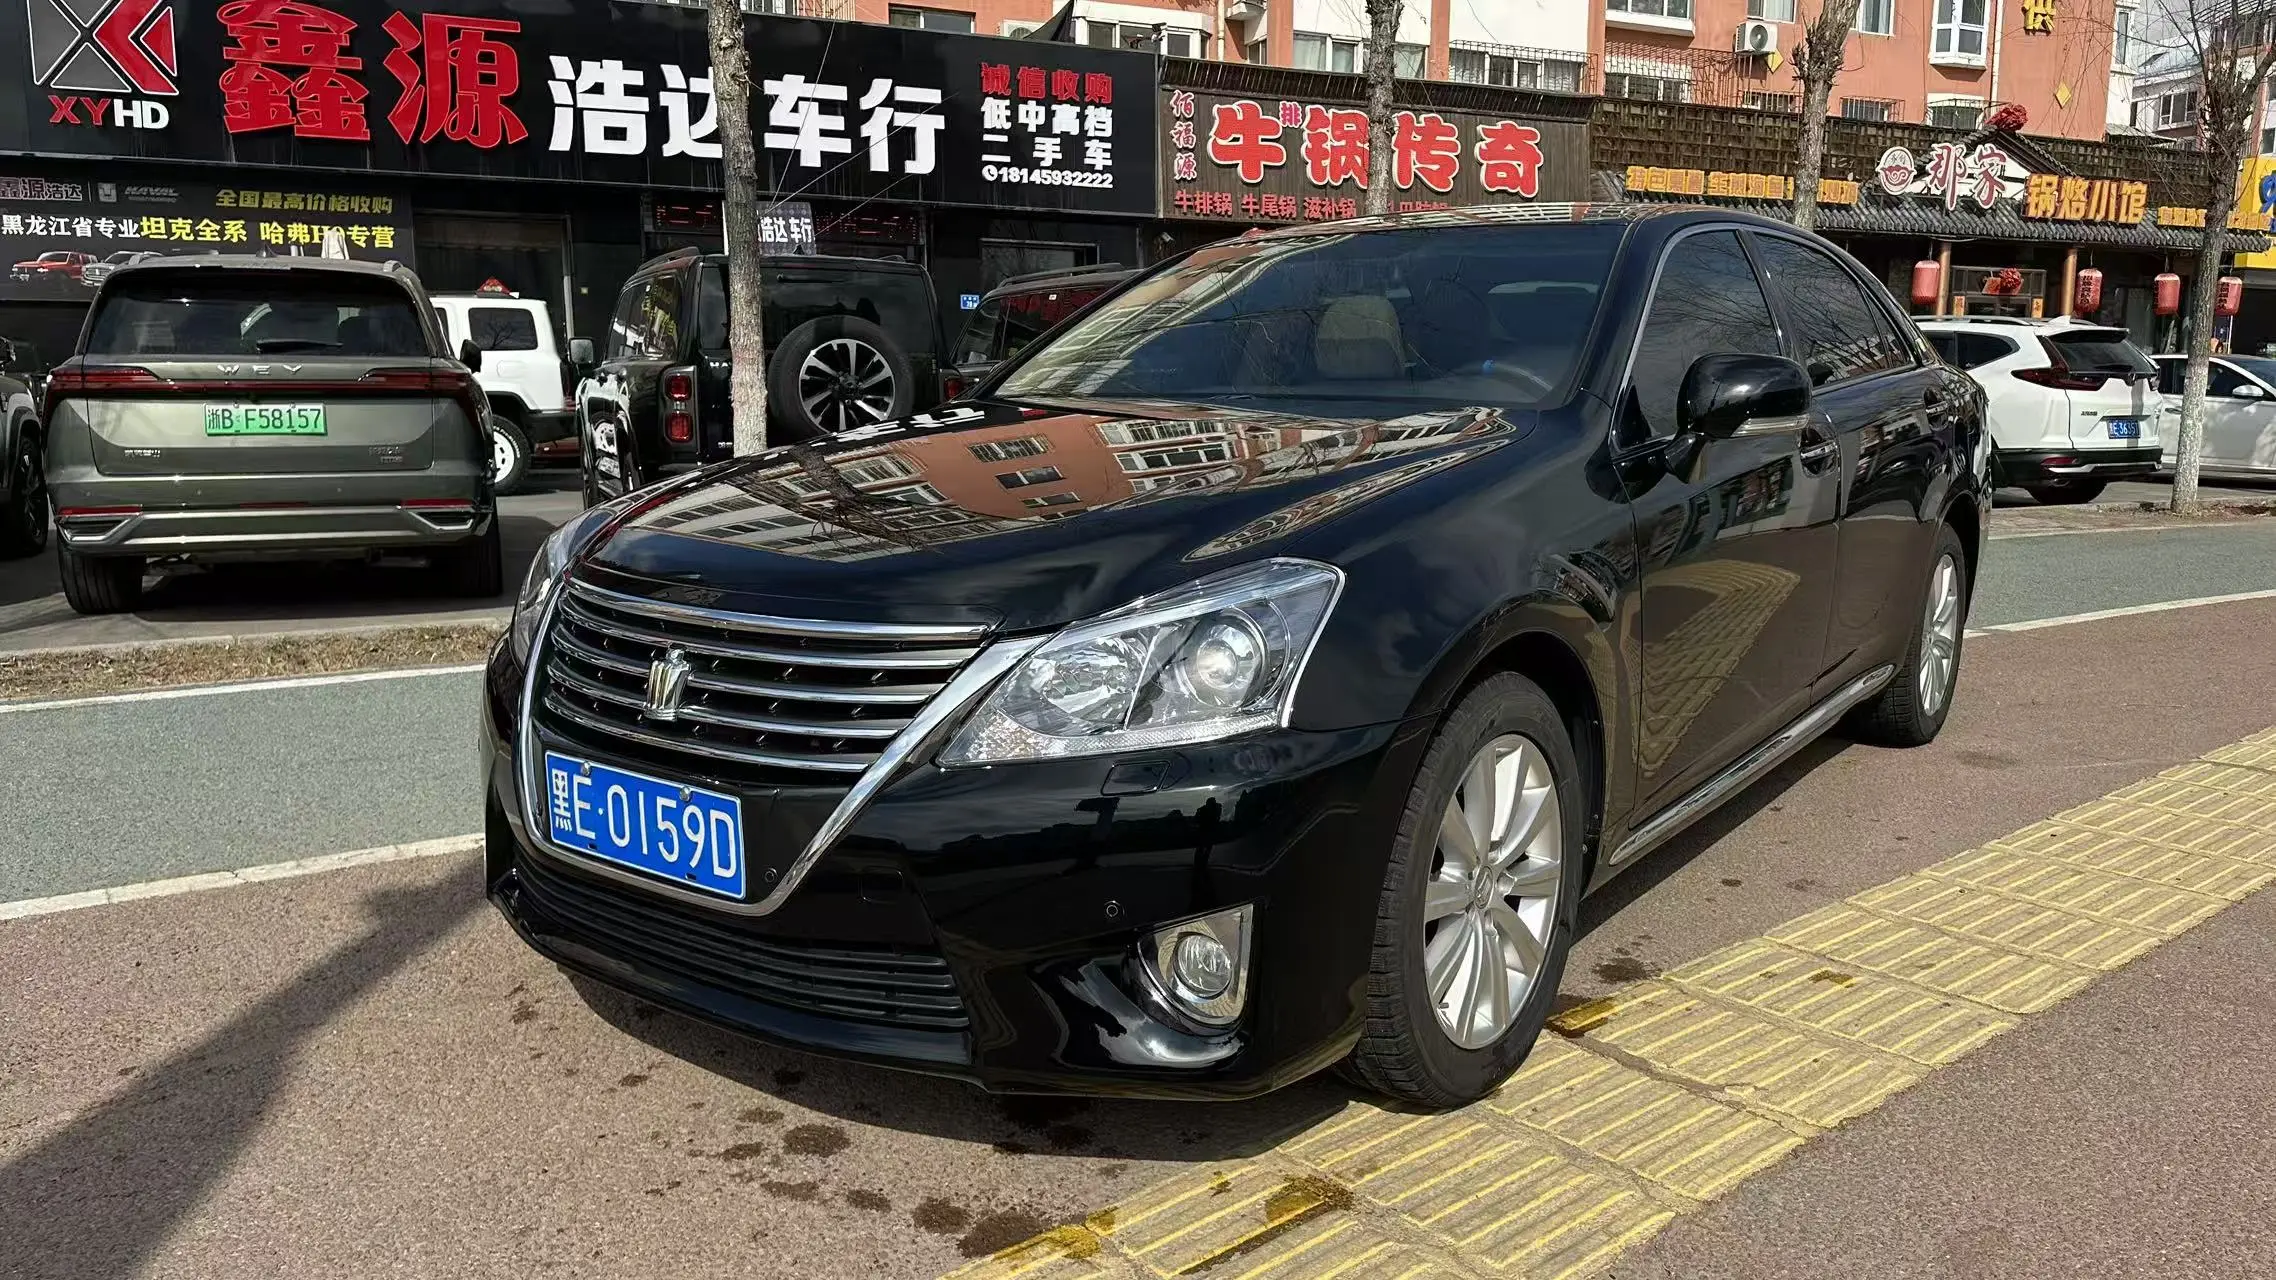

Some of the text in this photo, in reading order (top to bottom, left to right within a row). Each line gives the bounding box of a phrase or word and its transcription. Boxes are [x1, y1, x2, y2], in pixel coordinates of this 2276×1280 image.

[217, 0, 529, 149] 鑫源
[981, 62, 1112, 103] 诚信收购
[49, 95, 169, 129] XYHD
[981, 97, 1112, 137] 低中高档
[981, 134, 1112, 170] 二手车
[1170, 90, 1197, 180] 佰福源
[998, 167, 1113, 188] 18145932222
[1925, 143, 2007, 210] 那家
[215, 189, 393, 214] 全国最高价格收购
[1175, 190, 1233, 215] 牛排锅
[1241, 193, 1296, 218] 牛尾锅
[2027, 174, 2148, 224] 锅烙小馆
[217, 364, 303, 376] WEY
